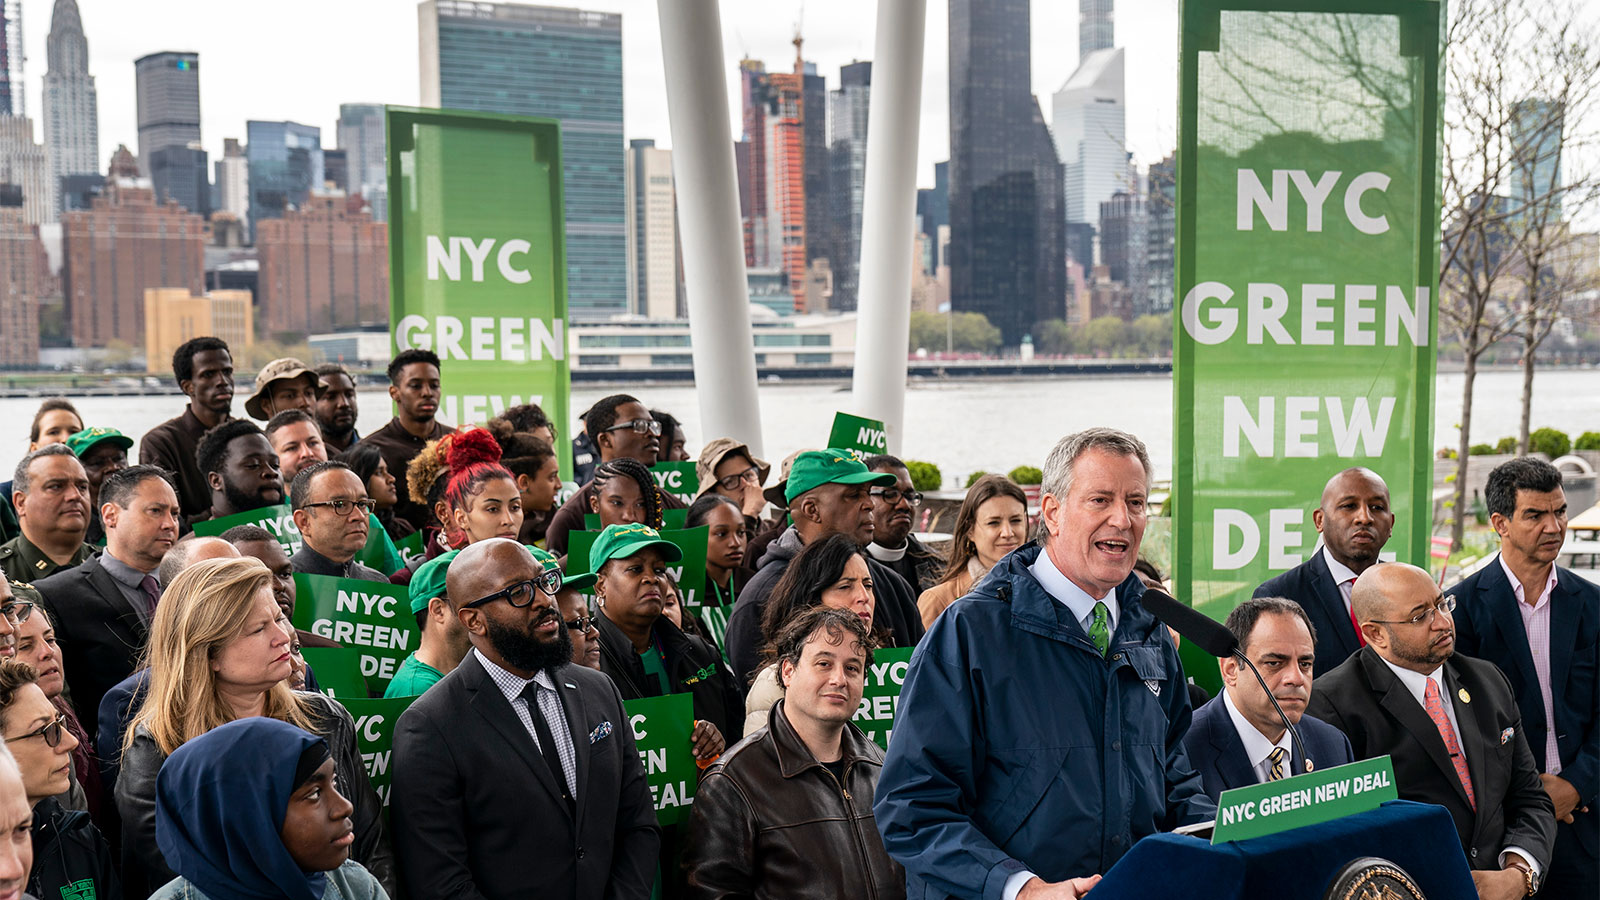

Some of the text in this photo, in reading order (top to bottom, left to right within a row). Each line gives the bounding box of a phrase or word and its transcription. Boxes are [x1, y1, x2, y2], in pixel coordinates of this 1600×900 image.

[1236, 168, 1391, 235] NYC
[426, 235, 532, 284] NYC
[1181, 281, 1430, 347] GREEN
[395, 314, 565, 361] GREEN
[857, 426, 885, 449] NYC
[1222, 395, 1397, 458] NEW
[653, 470, 682, 488] YC
[336, 589, 398, 618] NYC
[311, 618, 410, 651] GREEN
[360, 654, 406, 680] DE
[864, 661, 910, 687] YC
[649, 780, 695, 811] EAL
[1222, 770, 1391, 826] NYC GREEN NEW DEAL
